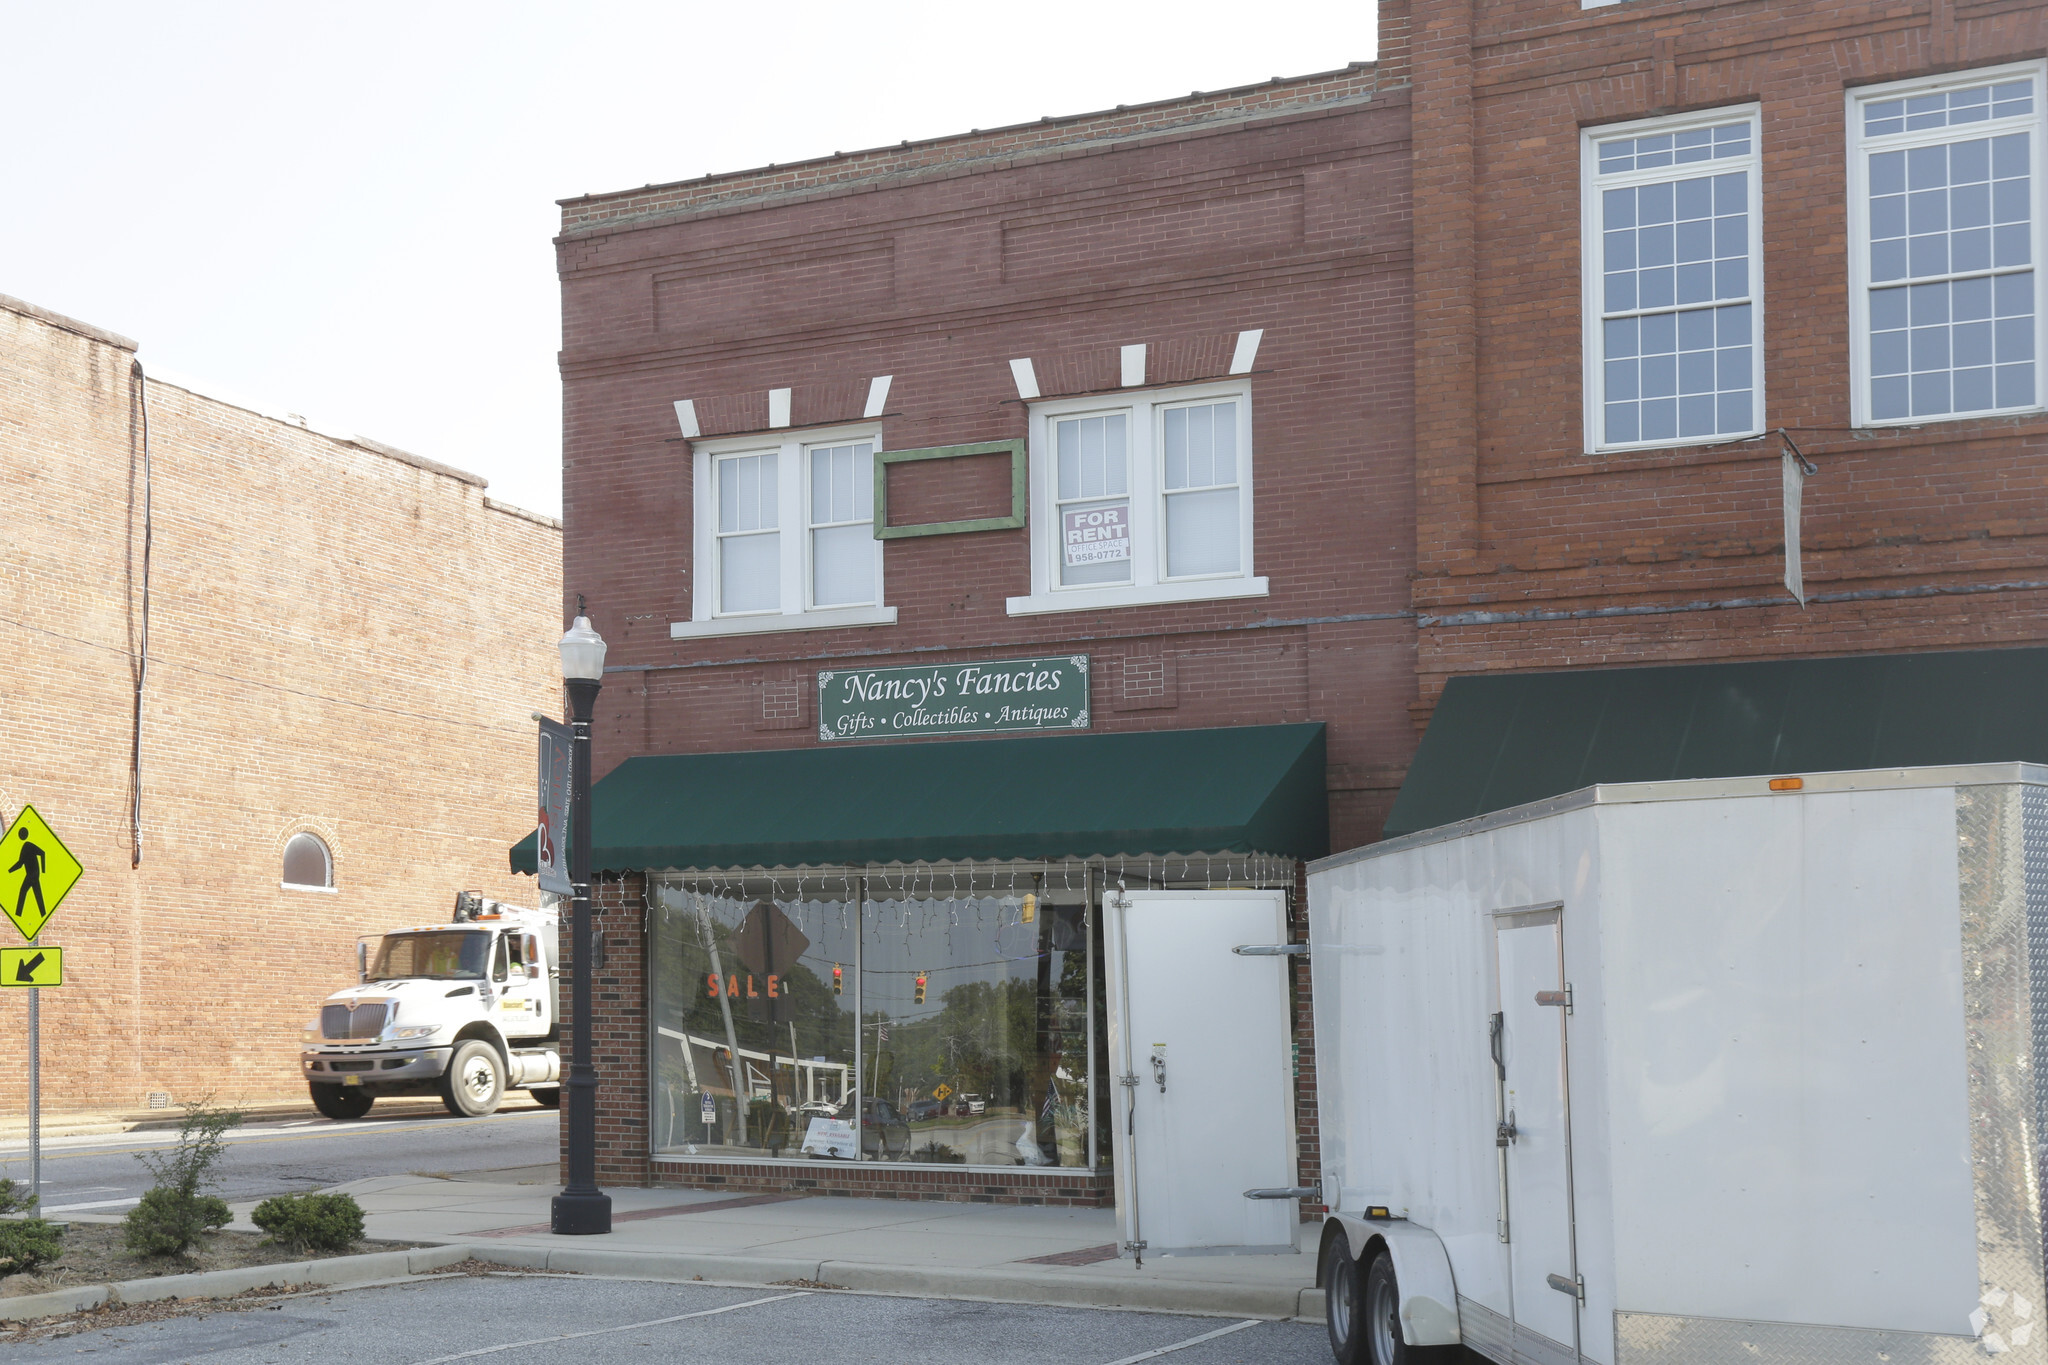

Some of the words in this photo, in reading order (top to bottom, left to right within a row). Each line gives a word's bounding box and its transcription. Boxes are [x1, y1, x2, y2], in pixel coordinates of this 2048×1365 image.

[1074, 510, 1119, 528] FOR
[1067, 524, 1126, 544] RENT
[1071, 541, 1098, 553] OFFICE
[1099, 539, 1123, 550] SPACE
[1075, 549, 1122, 562] 958-0772
[842, 670, 947, 708] Nancy's
[956, 662, 1063, 695] Fancies
[837, 711, 875, 735] Gifts
[892, 706, 979, 729] Collectibles
[994, 703, 1069, 725] Antiques
[707, 973, 779, 998] SALE
